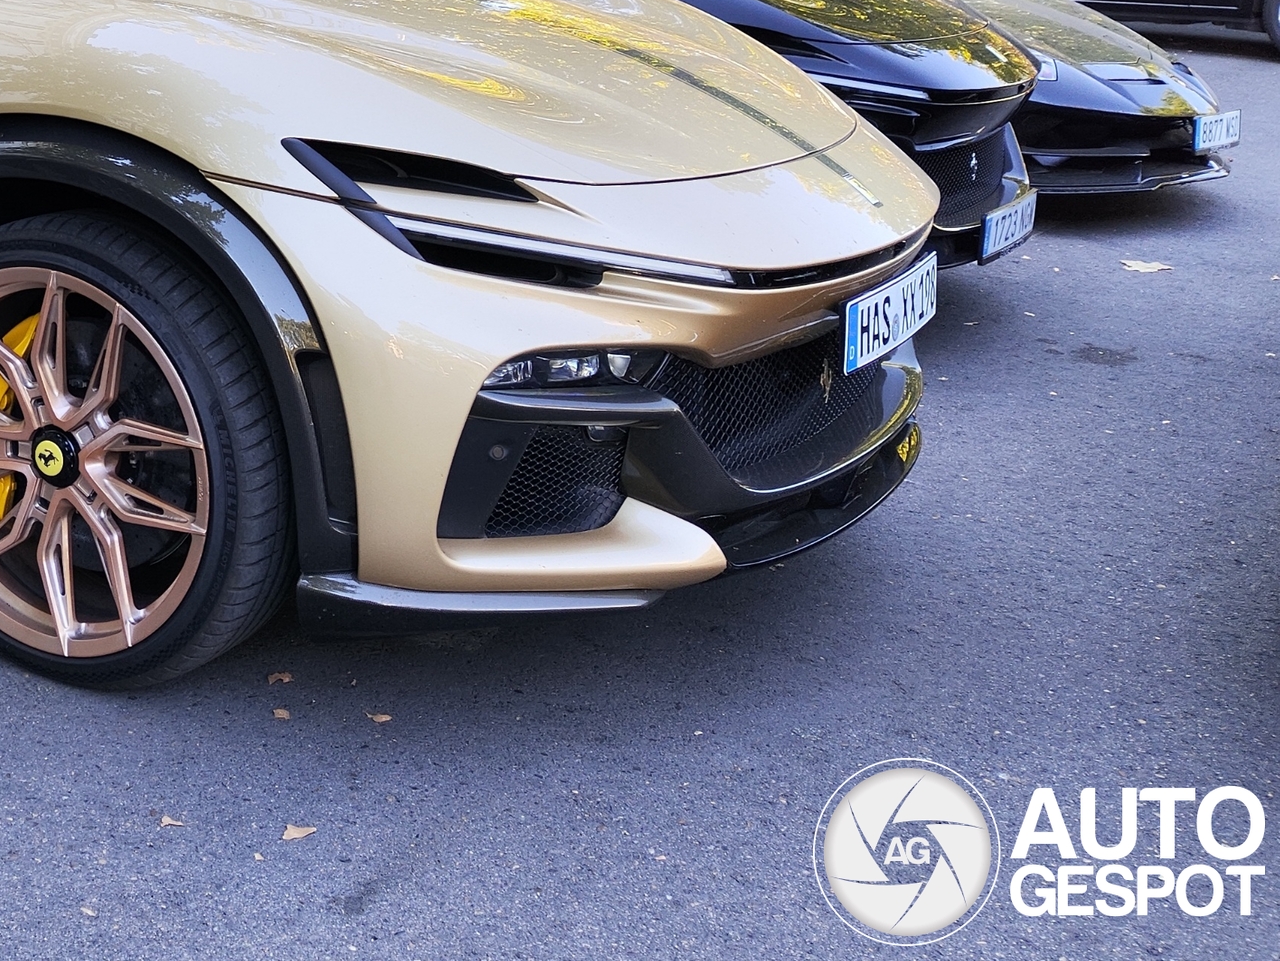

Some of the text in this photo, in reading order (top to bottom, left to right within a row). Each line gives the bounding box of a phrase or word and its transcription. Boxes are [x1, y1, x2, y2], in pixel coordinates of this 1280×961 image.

[1202, 118, 1224, 143] 8877
[993, 209, 1018, 248] 1723
[860, 295, 891, 358] HAS
[901, 279, 917, 334] XX
[218, 428, 238, 532] MICHELIN
